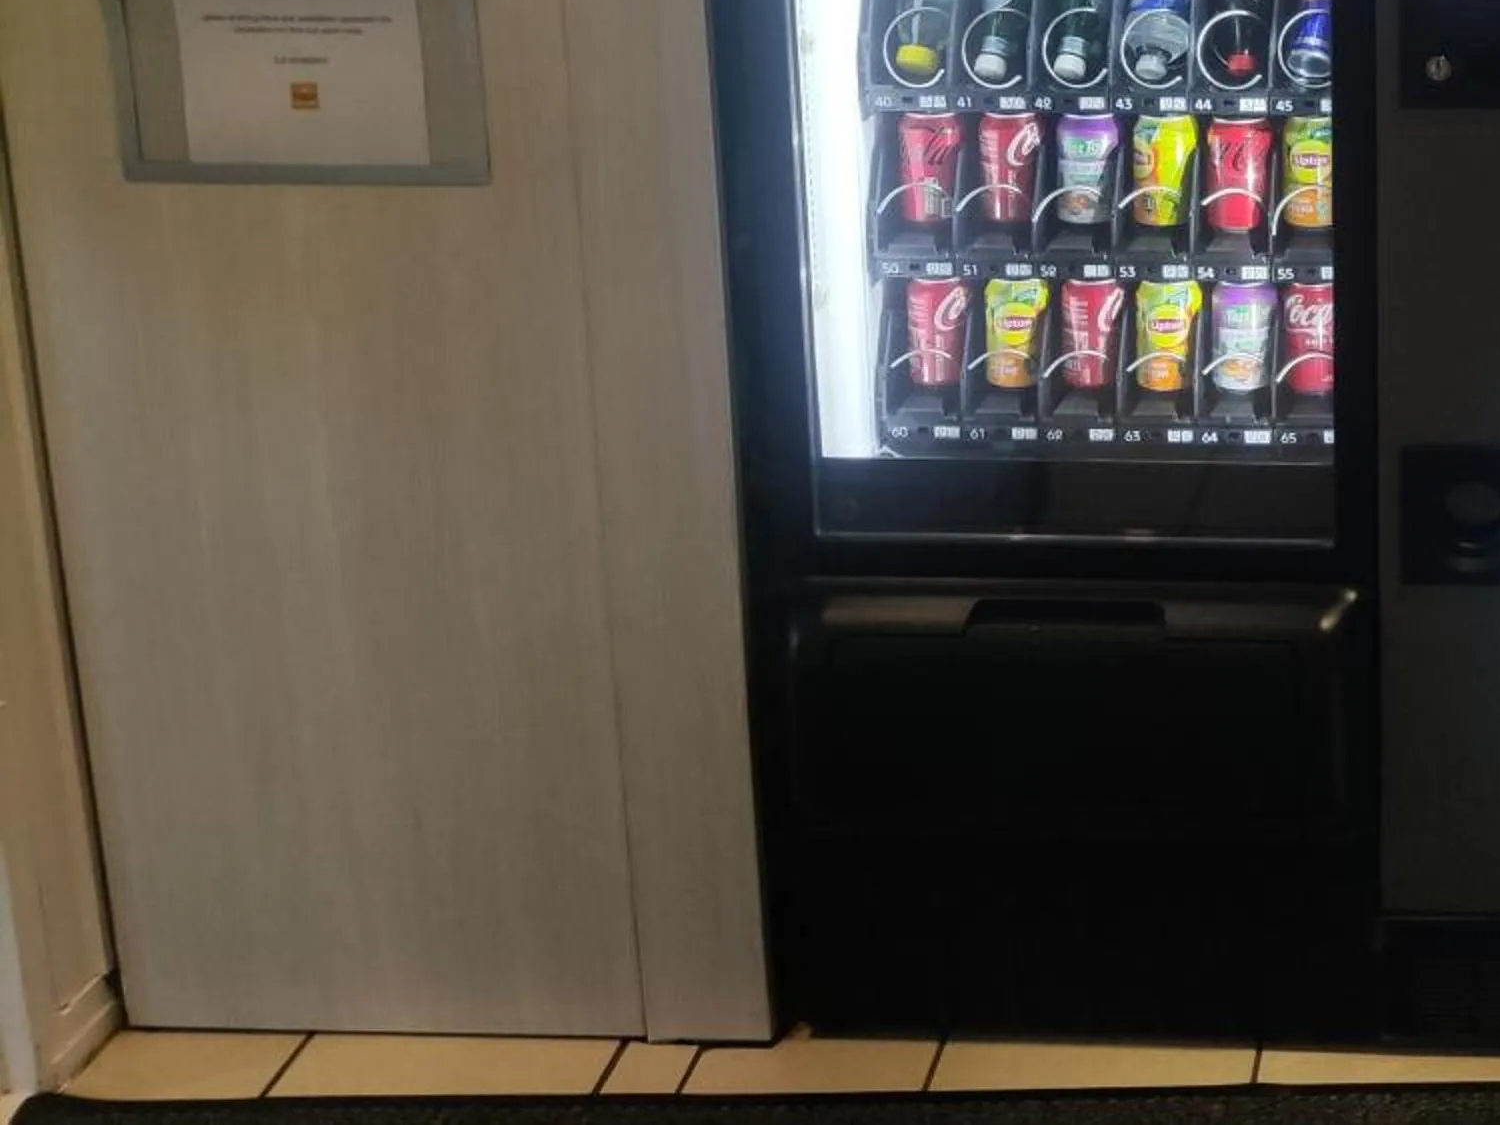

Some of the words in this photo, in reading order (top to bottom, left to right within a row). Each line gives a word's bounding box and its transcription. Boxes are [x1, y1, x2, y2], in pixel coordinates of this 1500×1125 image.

[956, 97, 973, 108] 41
[1034, 97, 1053, 109] 42
[1115, 98, 1133, 111] 43
[1195, 99, 1213, 111] 44
[1275, 99, 1294, 112] 45
[962, 264, 978, 276] 51
[1119, 266, 1137, 279] 53
[1197, 266, 1215, 280] 54
[1277, 267, 1295, 280] 55
[890, 426, 909, 439] 60
[969, 428, 985, 440] 61
[1046, 429, 1064, 441] 62
[1123, 430, 1142, 442] 63
[1201, 431, 1219, 444] 64
[1279, 432, 1297, 444] 65
